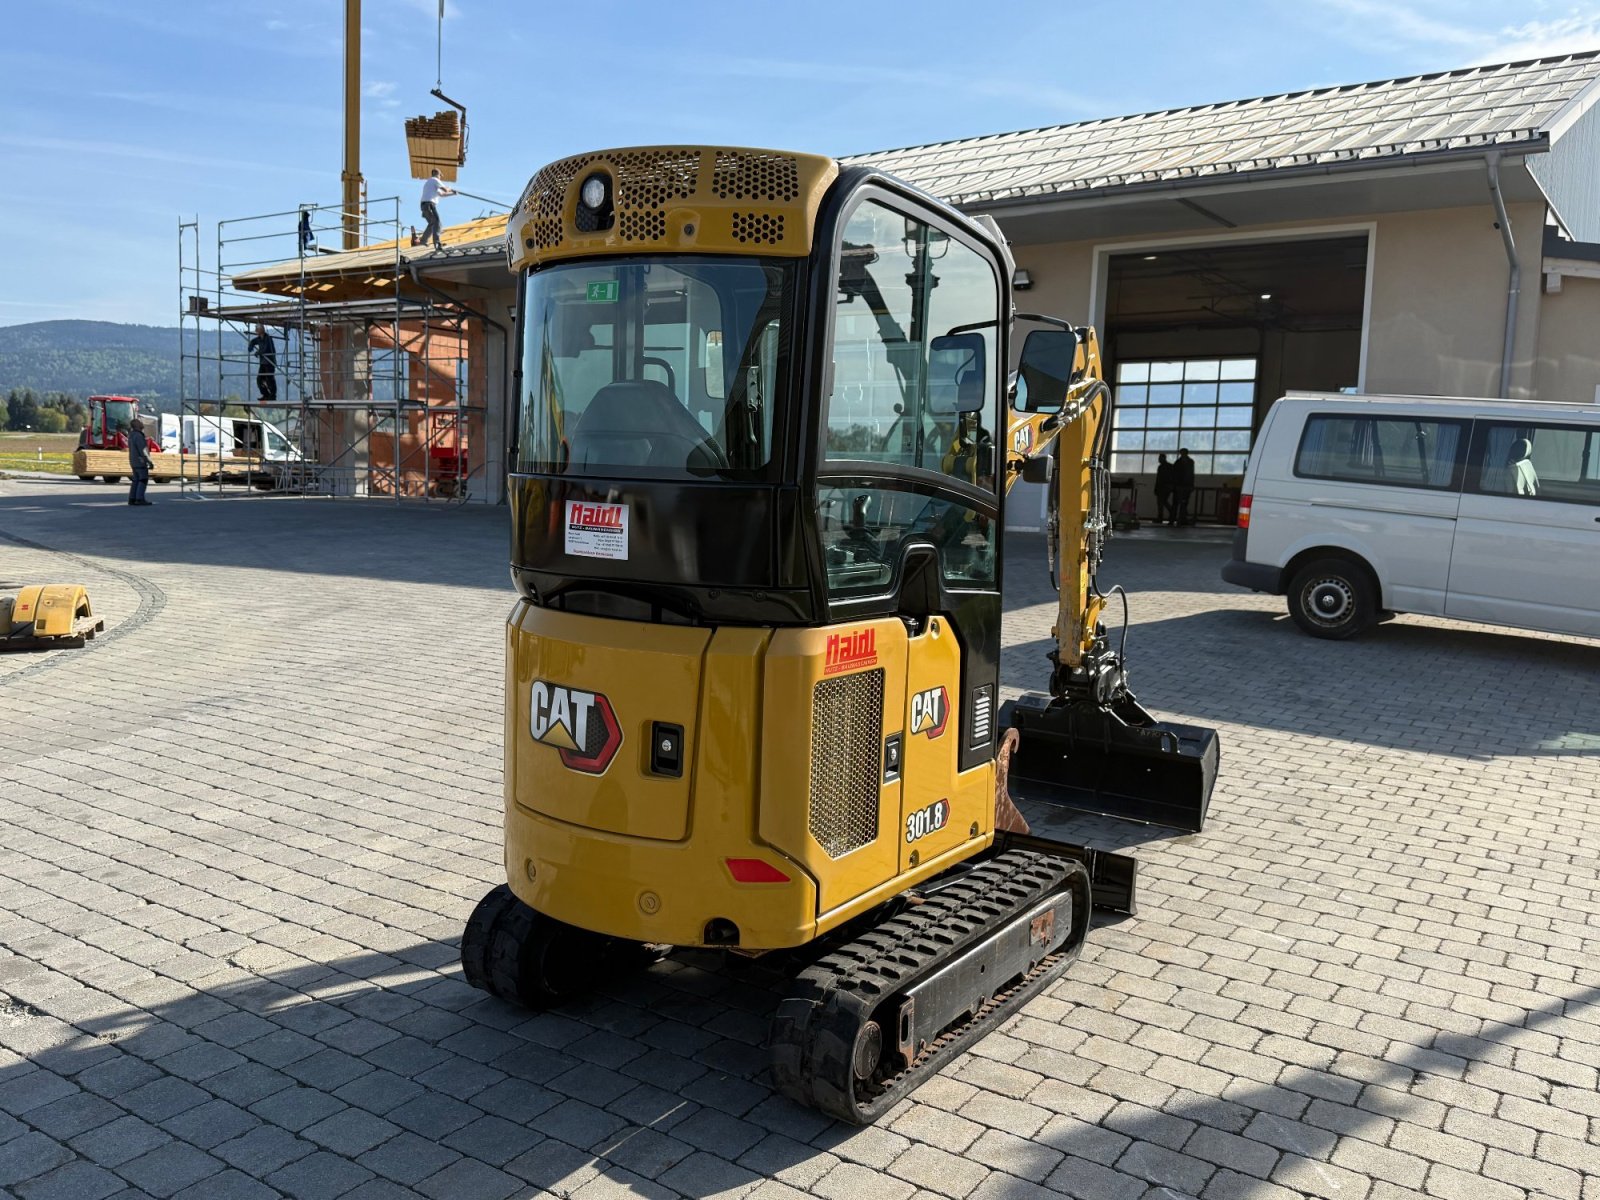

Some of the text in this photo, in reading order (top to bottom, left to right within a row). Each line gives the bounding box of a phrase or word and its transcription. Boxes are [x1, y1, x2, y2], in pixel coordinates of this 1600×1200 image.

[1014, 425, 1029, 452] CAT
[570, 503, 623, 527] Haidl
[825, 628, 877, 665] Haidl
[530, 681, 595, 752] CAT
[911, 687, 942, 733] CAT
[906, 802, 943, 842] 301.8
